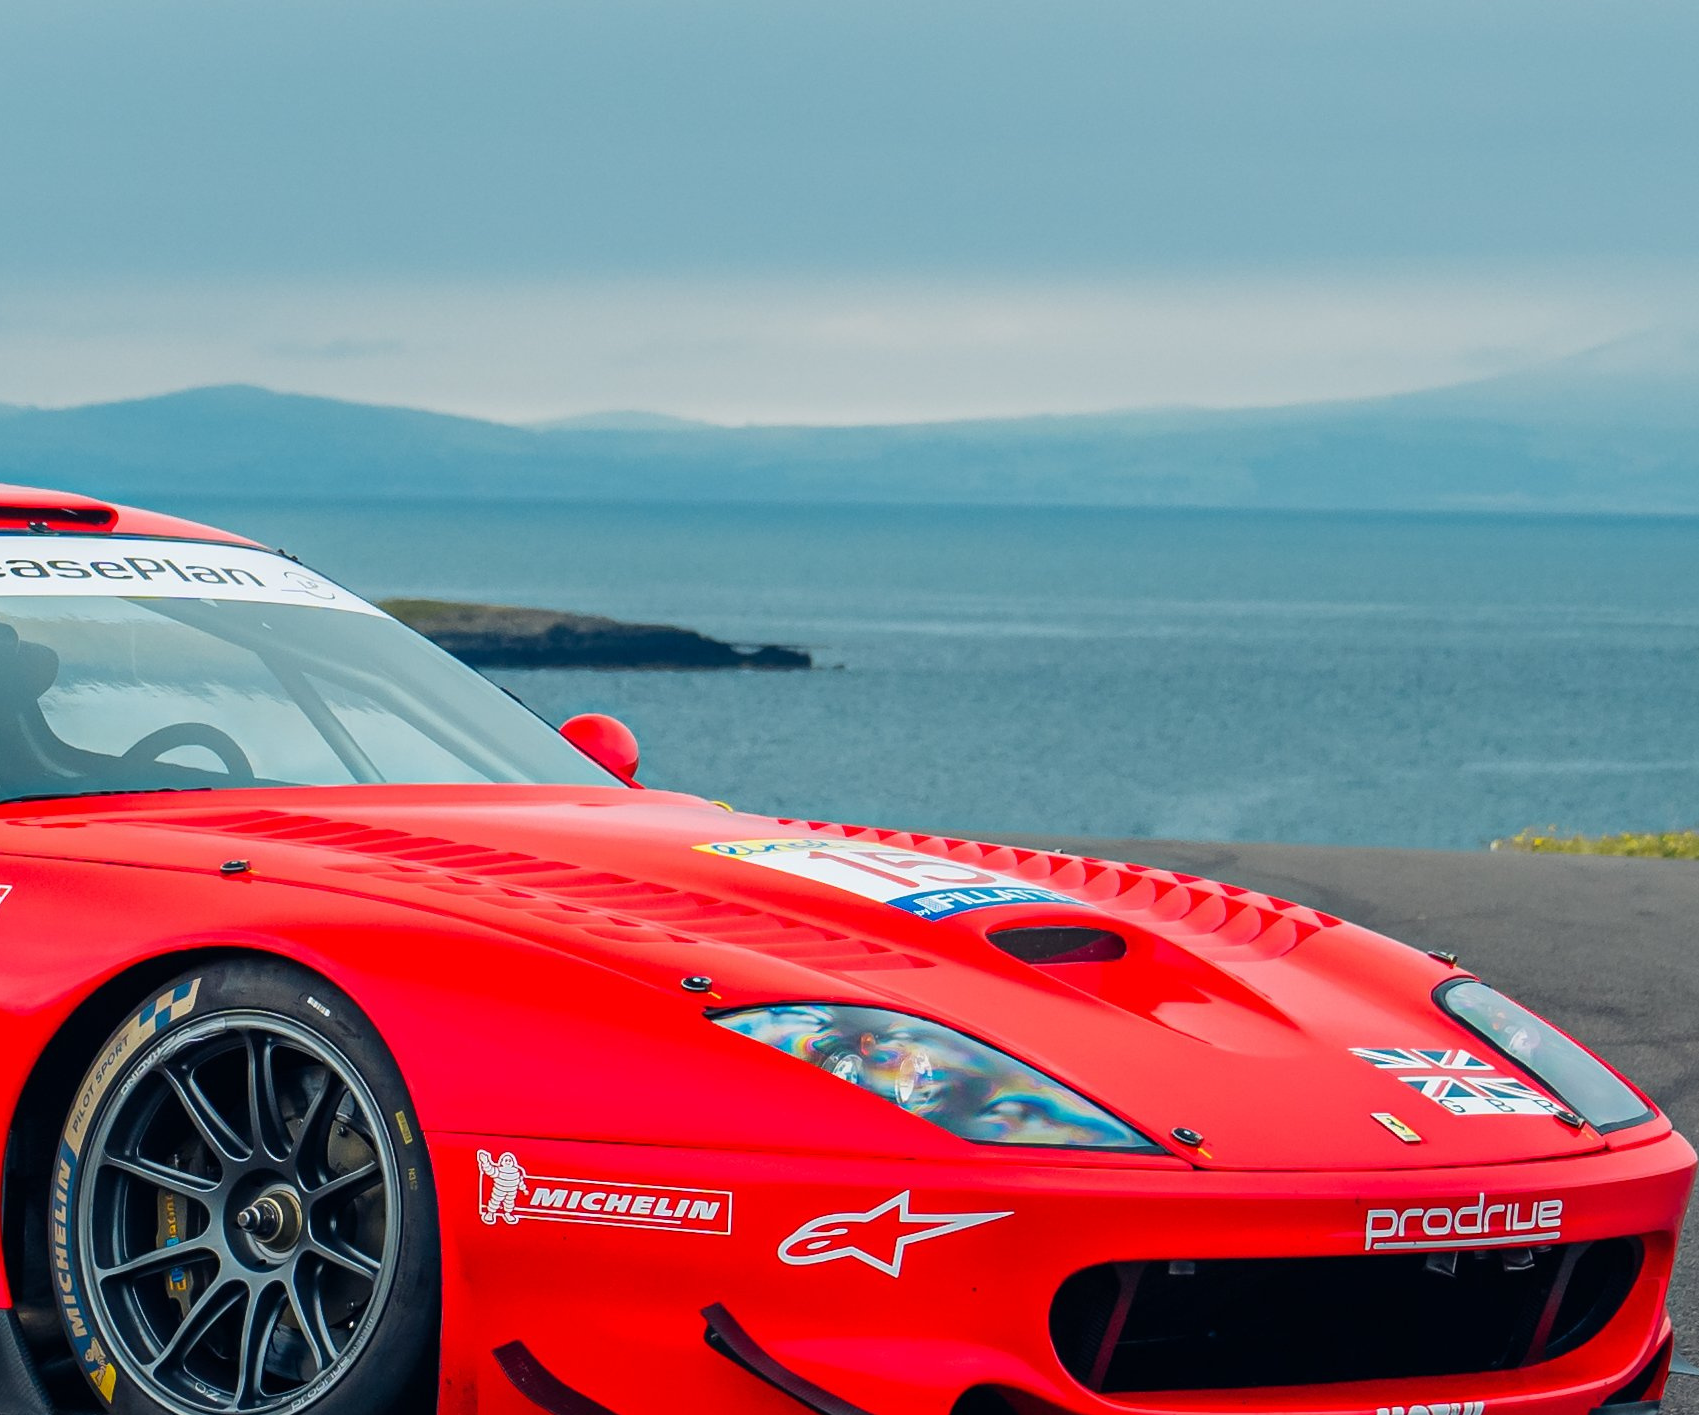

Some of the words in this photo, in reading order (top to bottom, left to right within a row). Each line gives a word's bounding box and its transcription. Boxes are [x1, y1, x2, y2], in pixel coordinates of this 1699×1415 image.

[808, 851, 997, 889] 15
[71, 1083, 95, 1134] PILOT
[95, 1034, 130, 1084] SPORT
[529, 1187, 721, 1221] MICHELIN
[1364, 1192, 1563, 1251] prodrive
[55, 1157, 88, 1338] MICHELIN
[194, 1382, 221, 1402] OZ
